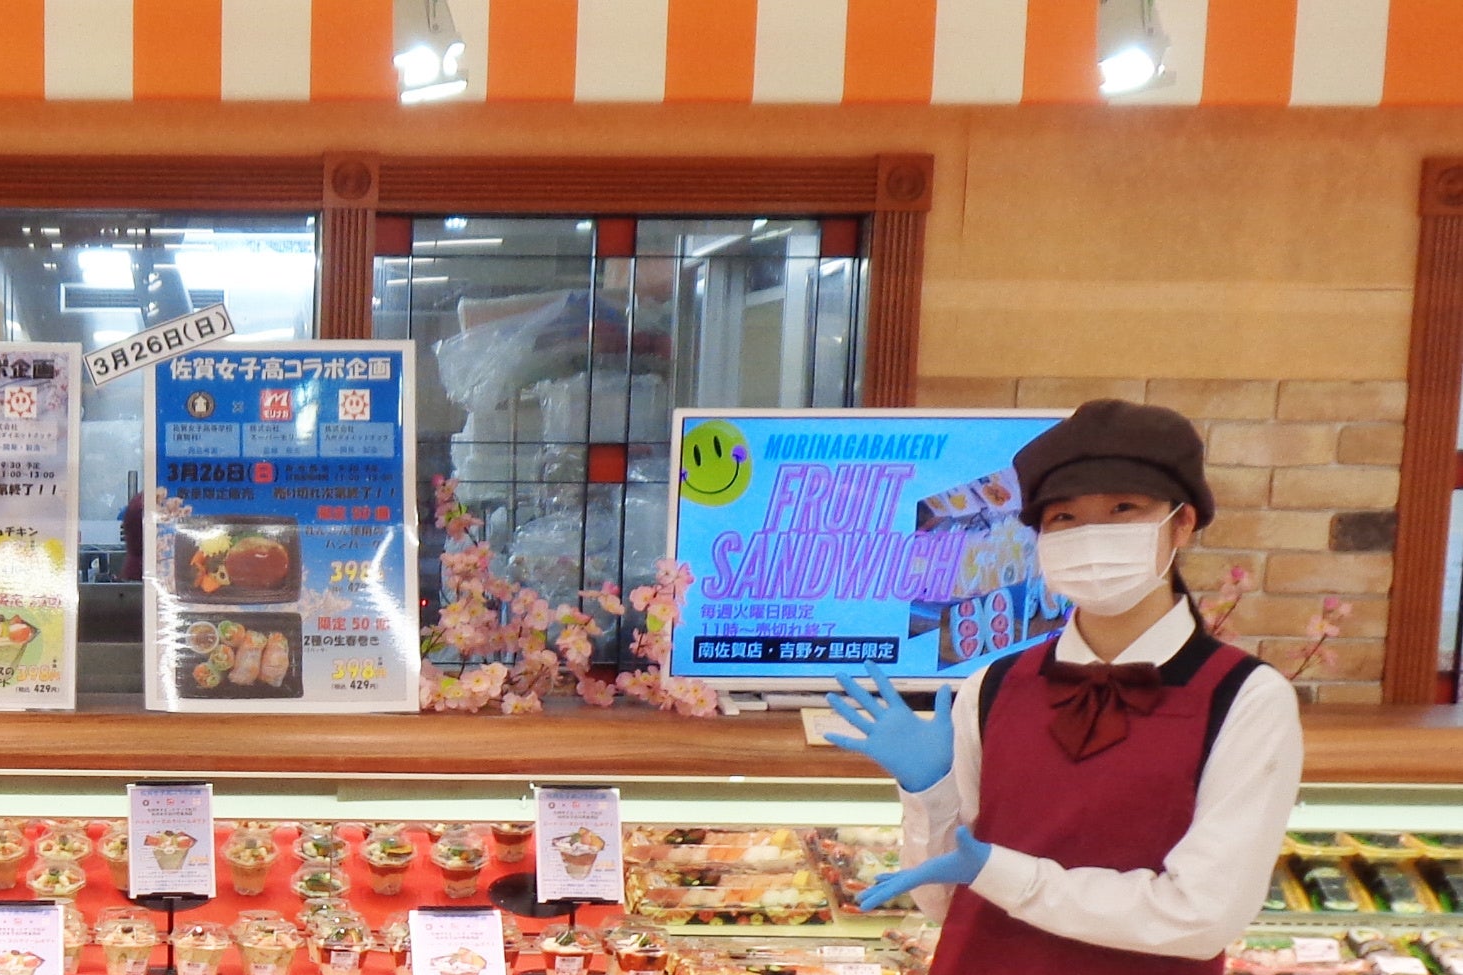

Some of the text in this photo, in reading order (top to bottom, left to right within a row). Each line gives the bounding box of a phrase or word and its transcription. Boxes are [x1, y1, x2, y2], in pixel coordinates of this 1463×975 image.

[93, 311, 229, 376] 3月26日(日)
[170, 357, 391, 381] 佐賀女子高コラボ企画
[763, 433, 949, 461] MORINAGABAKERY
[760, 463, 917, 535] FRUIT
[701, 530, 970, 602] SANDWICH
[318, 617, 347, 631] 限定
[701, 604, 814, 620] 毎週火曜日限定
[304, 635, 380, 647] 2種の生春巻き
[698, 642, 894, 660] 南佐賀店・吉野ヶ里店限定
